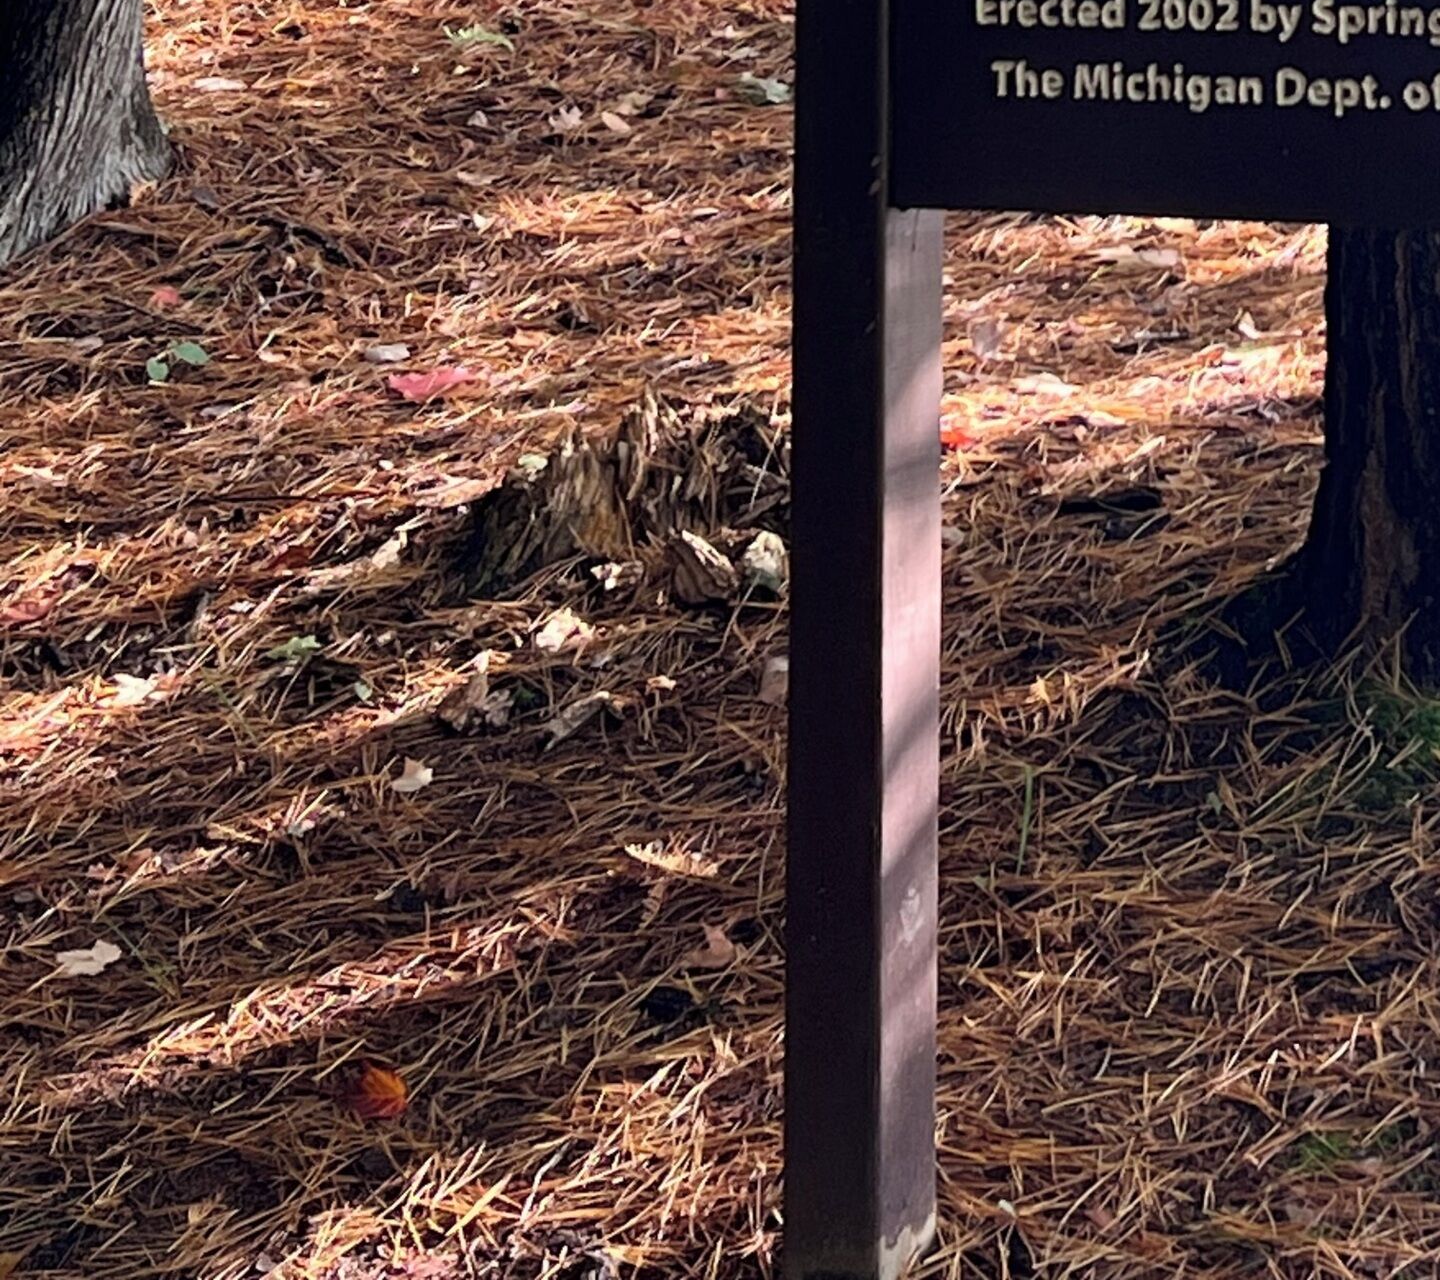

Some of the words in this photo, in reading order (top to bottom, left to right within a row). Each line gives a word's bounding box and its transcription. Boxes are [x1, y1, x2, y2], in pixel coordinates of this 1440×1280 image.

[990, 60, 1064, 99] The
[1072, 61, 1263, 113] Michigan
[1275, 67, 1392, 118] Dept.
